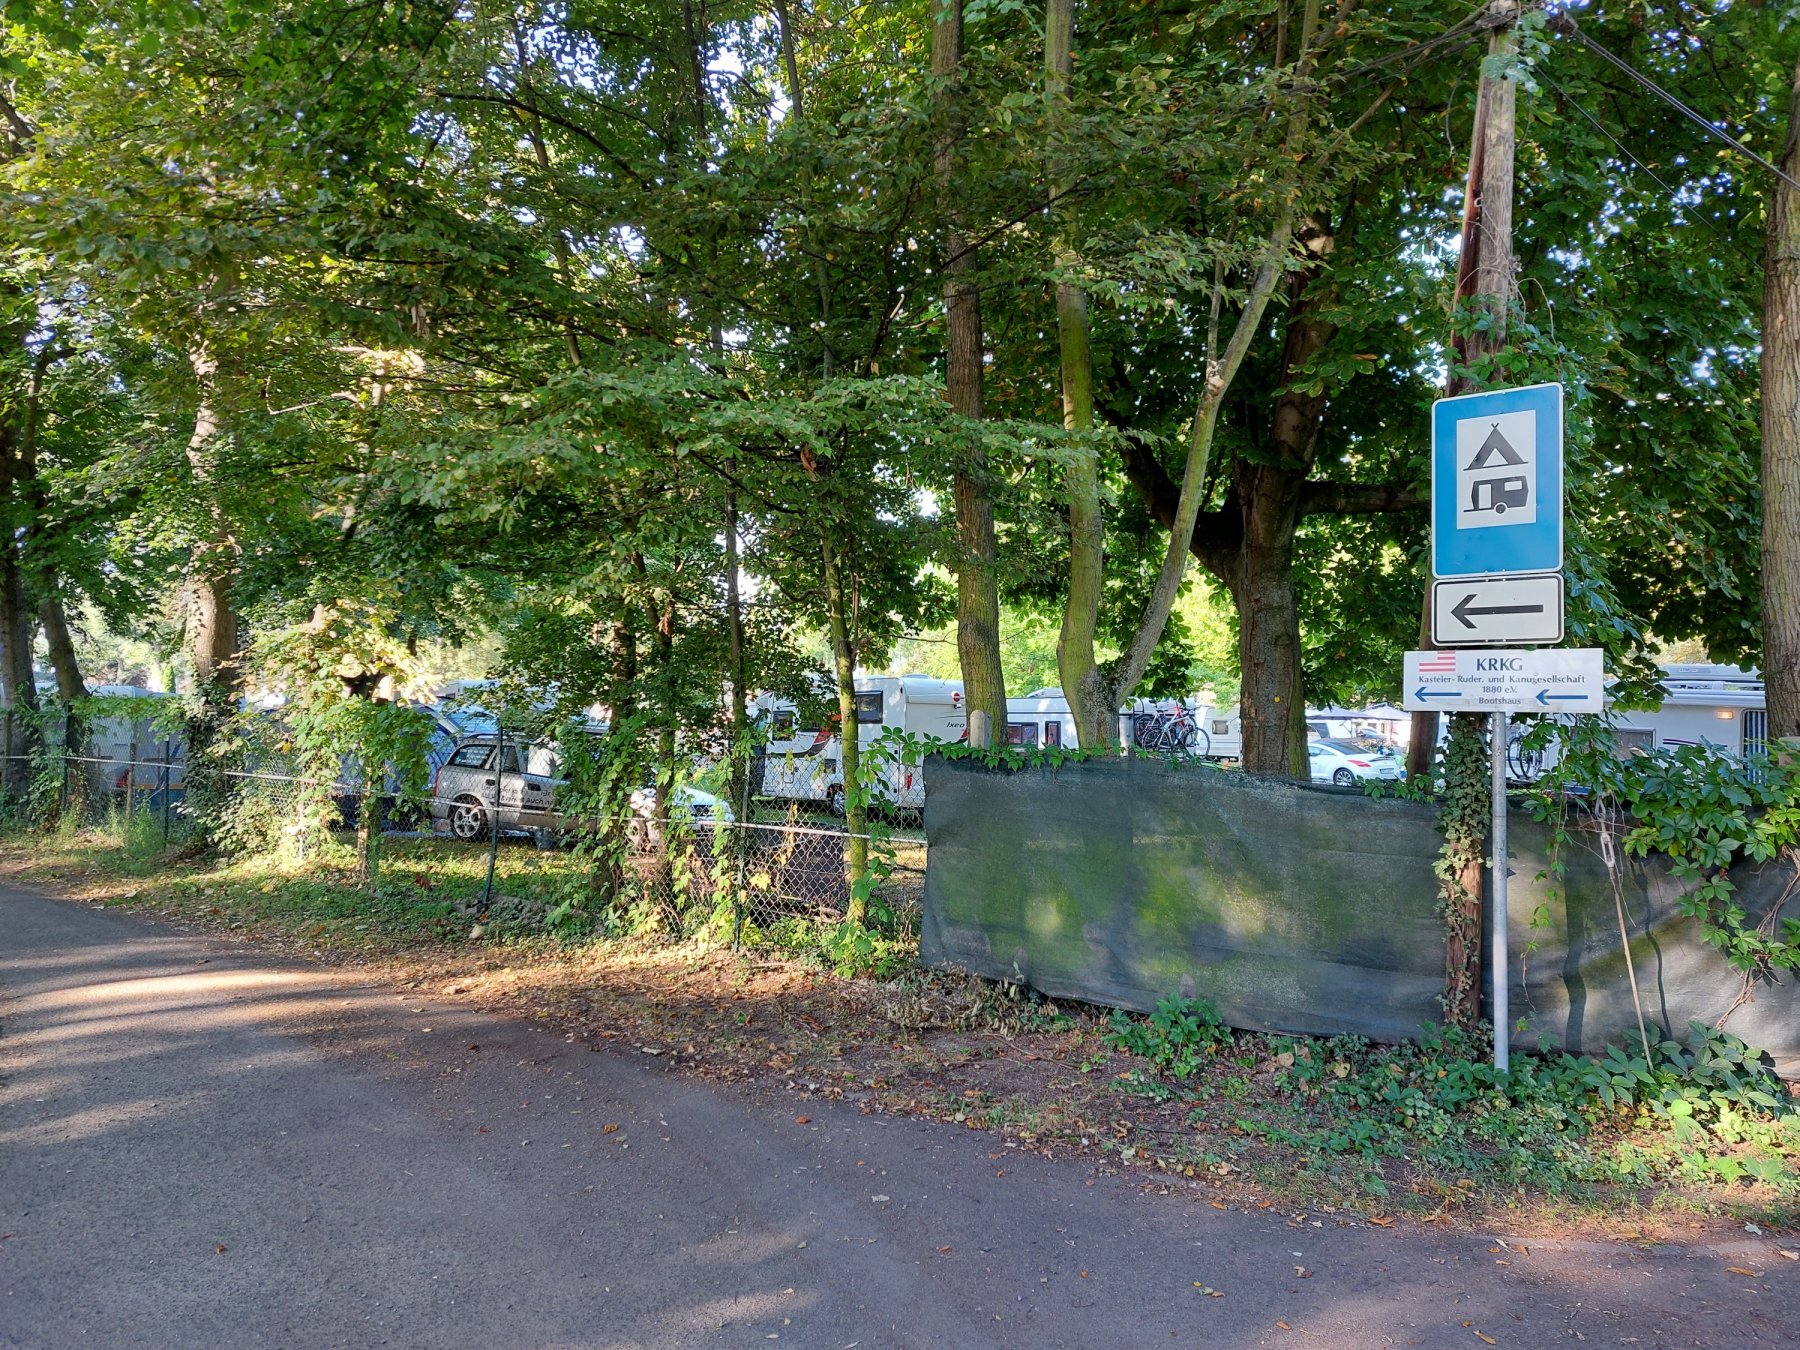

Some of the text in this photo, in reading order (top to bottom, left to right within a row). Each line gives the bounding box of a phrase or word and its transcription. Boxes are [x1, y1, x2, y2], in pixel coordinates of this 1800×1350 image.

[1476, 657, 1523, 671] KRKG
[1488, 675, 1505, 683] und
[1509, 675, 1585, 685] Kanugesellschaft
[1482, 685, 1502, 694] 1880
[1478, 696, 1522, 705] Bootshaus
